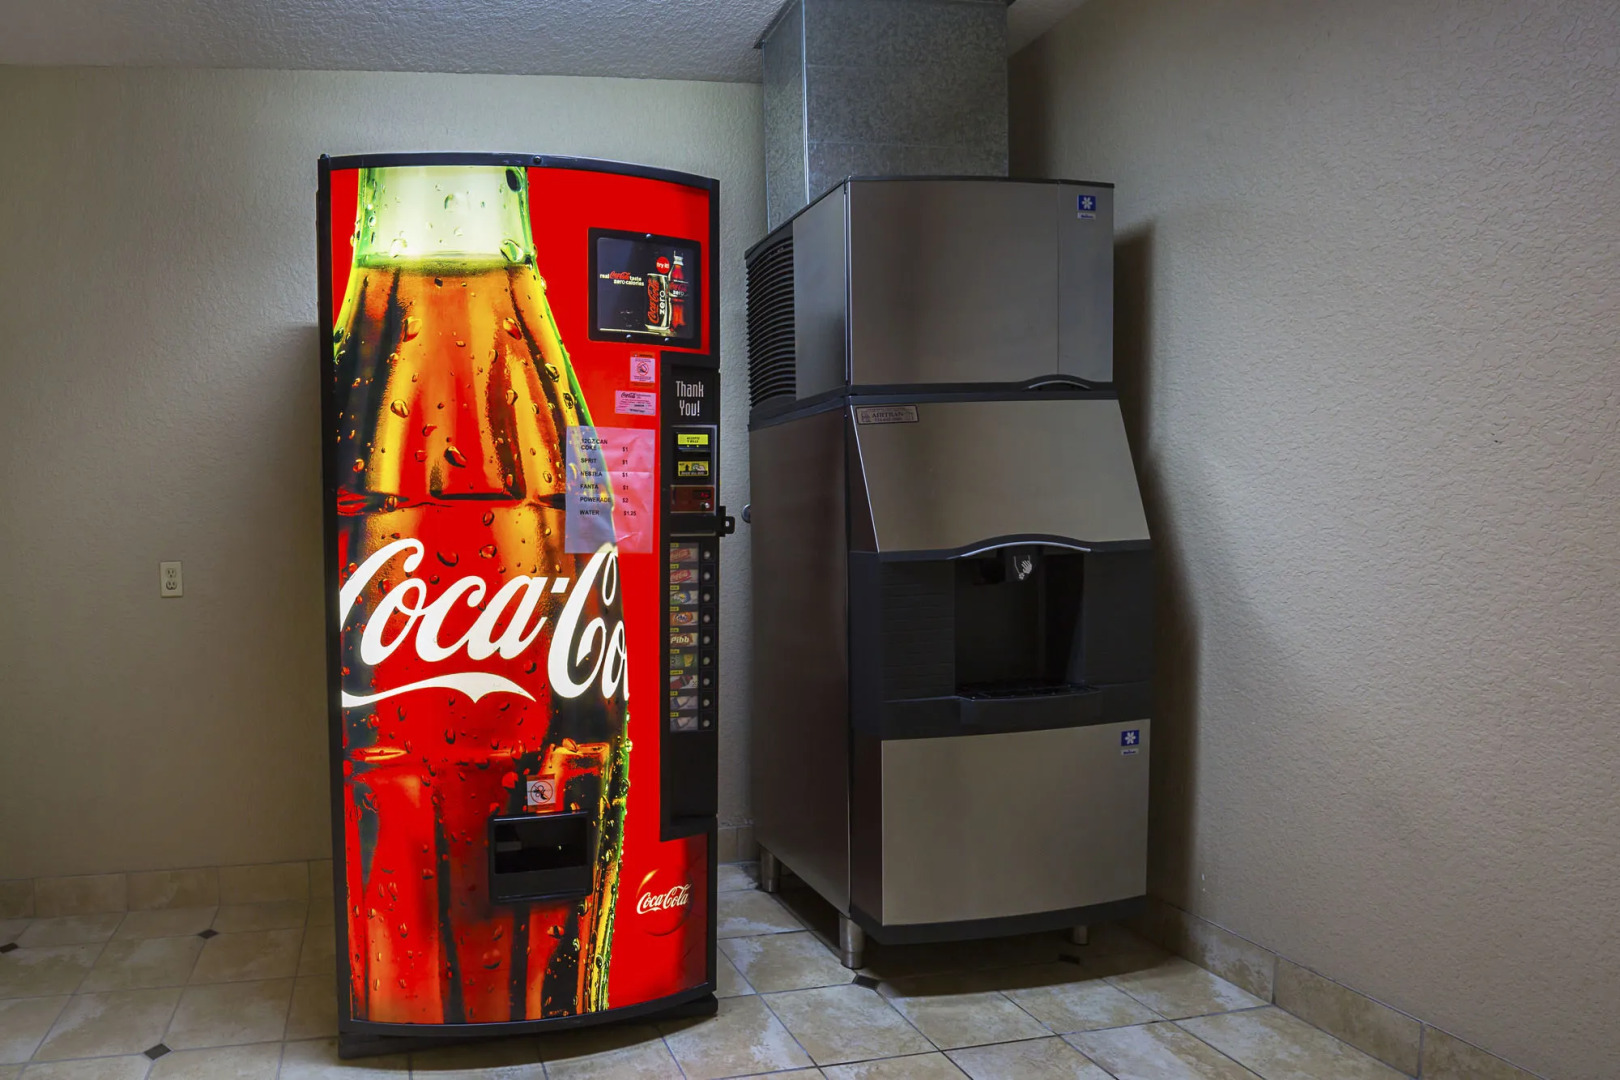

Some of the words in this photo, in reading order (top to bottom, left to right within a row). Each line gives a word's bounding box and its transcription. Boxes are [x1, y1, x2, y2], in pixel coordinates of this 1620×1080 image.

[676, 380, 704, 398] Thank
[679, 399, 700, 417] You!
[670, 636, 690, 644] Pibb
